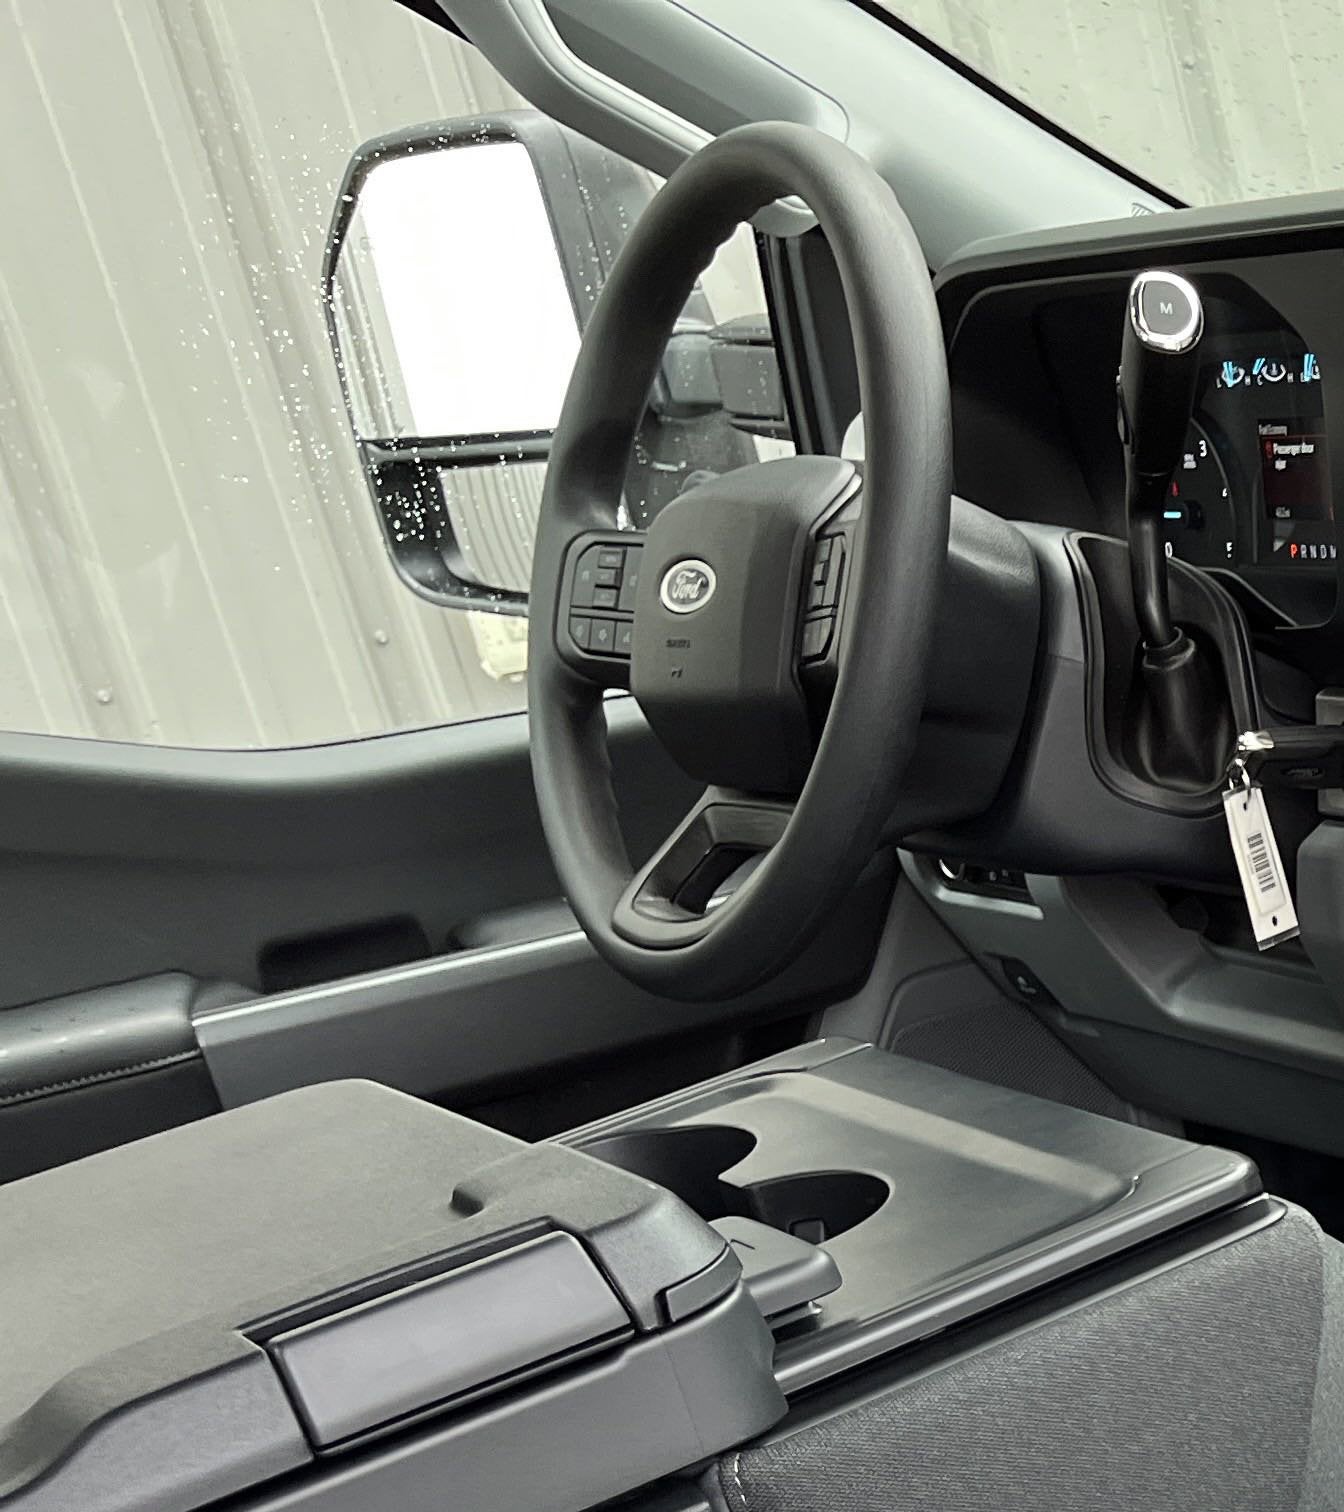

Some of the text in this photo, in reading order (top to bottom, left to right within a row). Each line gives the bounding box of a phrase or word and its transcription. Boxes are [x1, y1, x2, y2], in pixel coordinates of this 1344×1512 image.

[1160, 302, 1173, 314] M
[1199, 440, 1207, 457] 3
[1291, 544, 1298, 558] P
[672, 569, 707, 600] Ford
